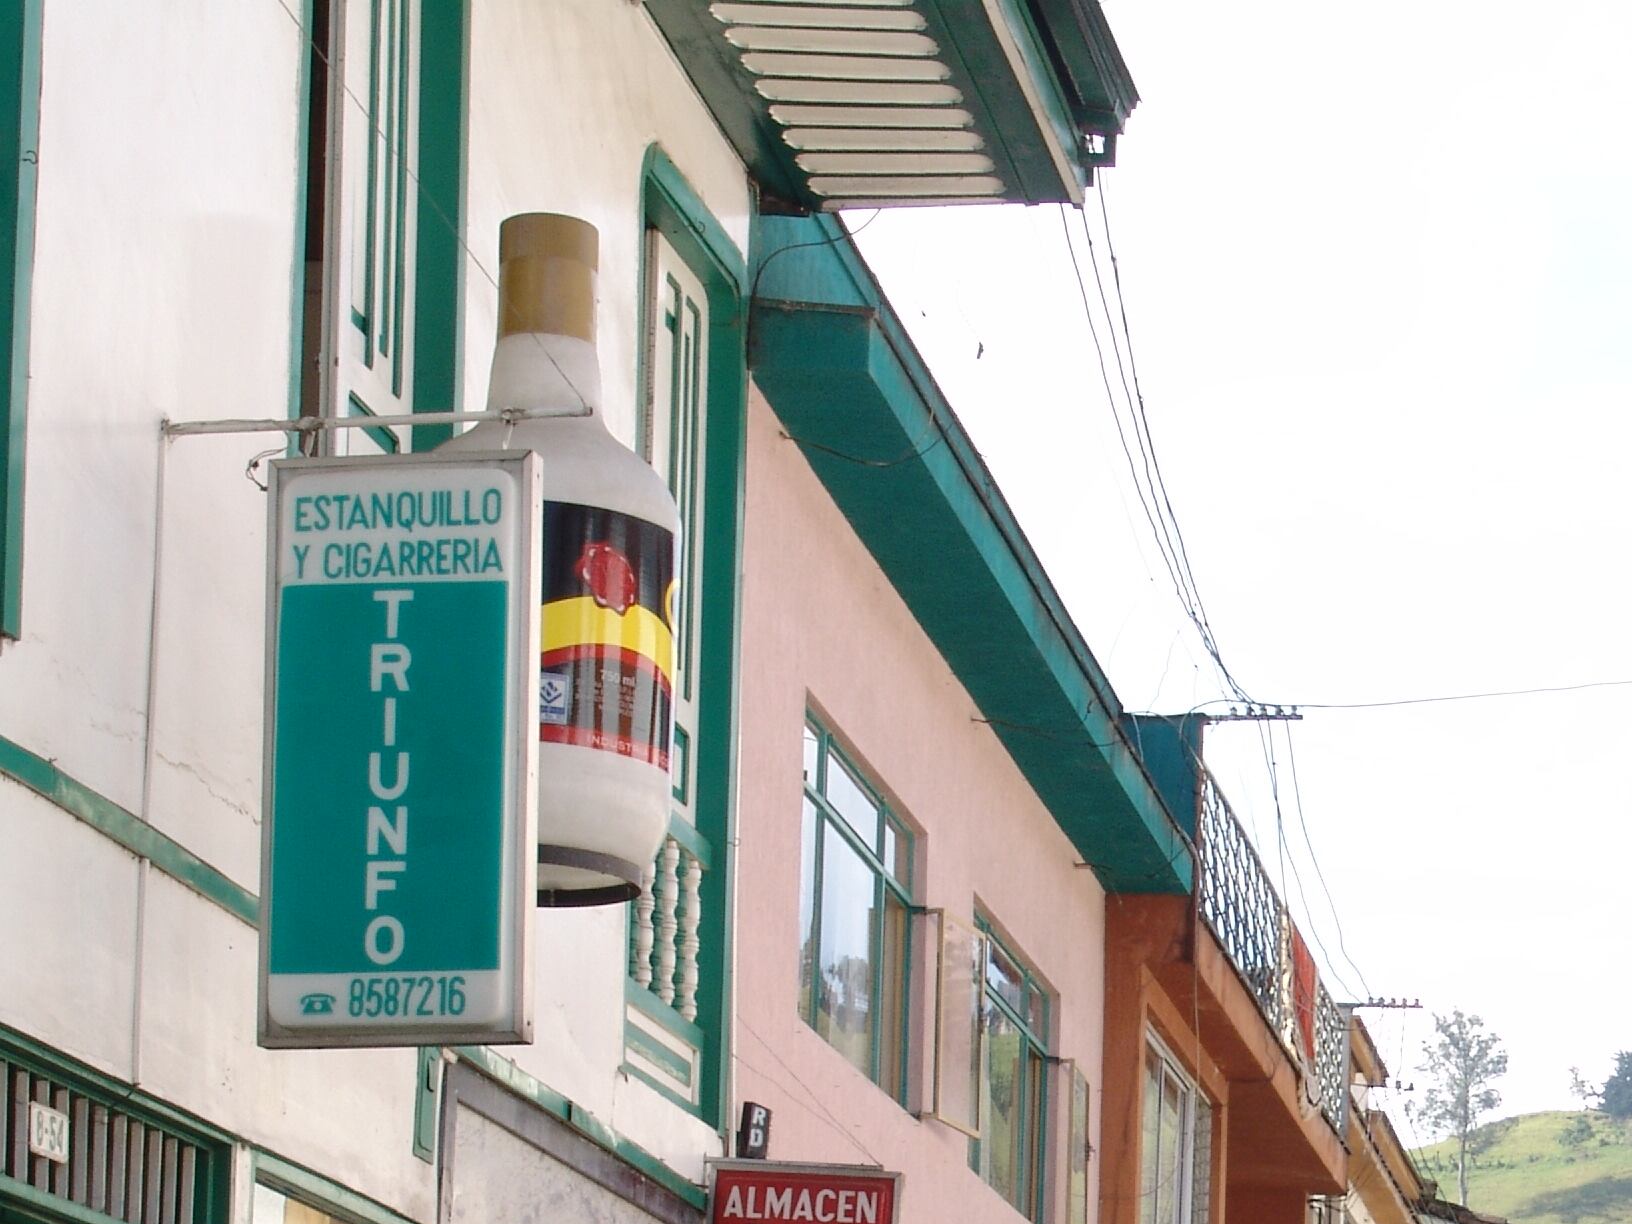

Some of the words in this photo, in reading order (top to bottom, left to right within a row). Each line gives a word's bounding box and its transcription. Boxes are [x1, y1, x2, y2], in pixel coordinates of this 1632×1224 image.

[294, 488, 503, 532] ESTANQUILLO
[292, 544, 310, 579] Y
[323, 537, 503, 579] CIGARRERIA
[364, 589, 414, 965] TRIUNFO
[348, 976, 466, 1018] 8587216
[723, 1185, 878, 1224] ALMACEN
